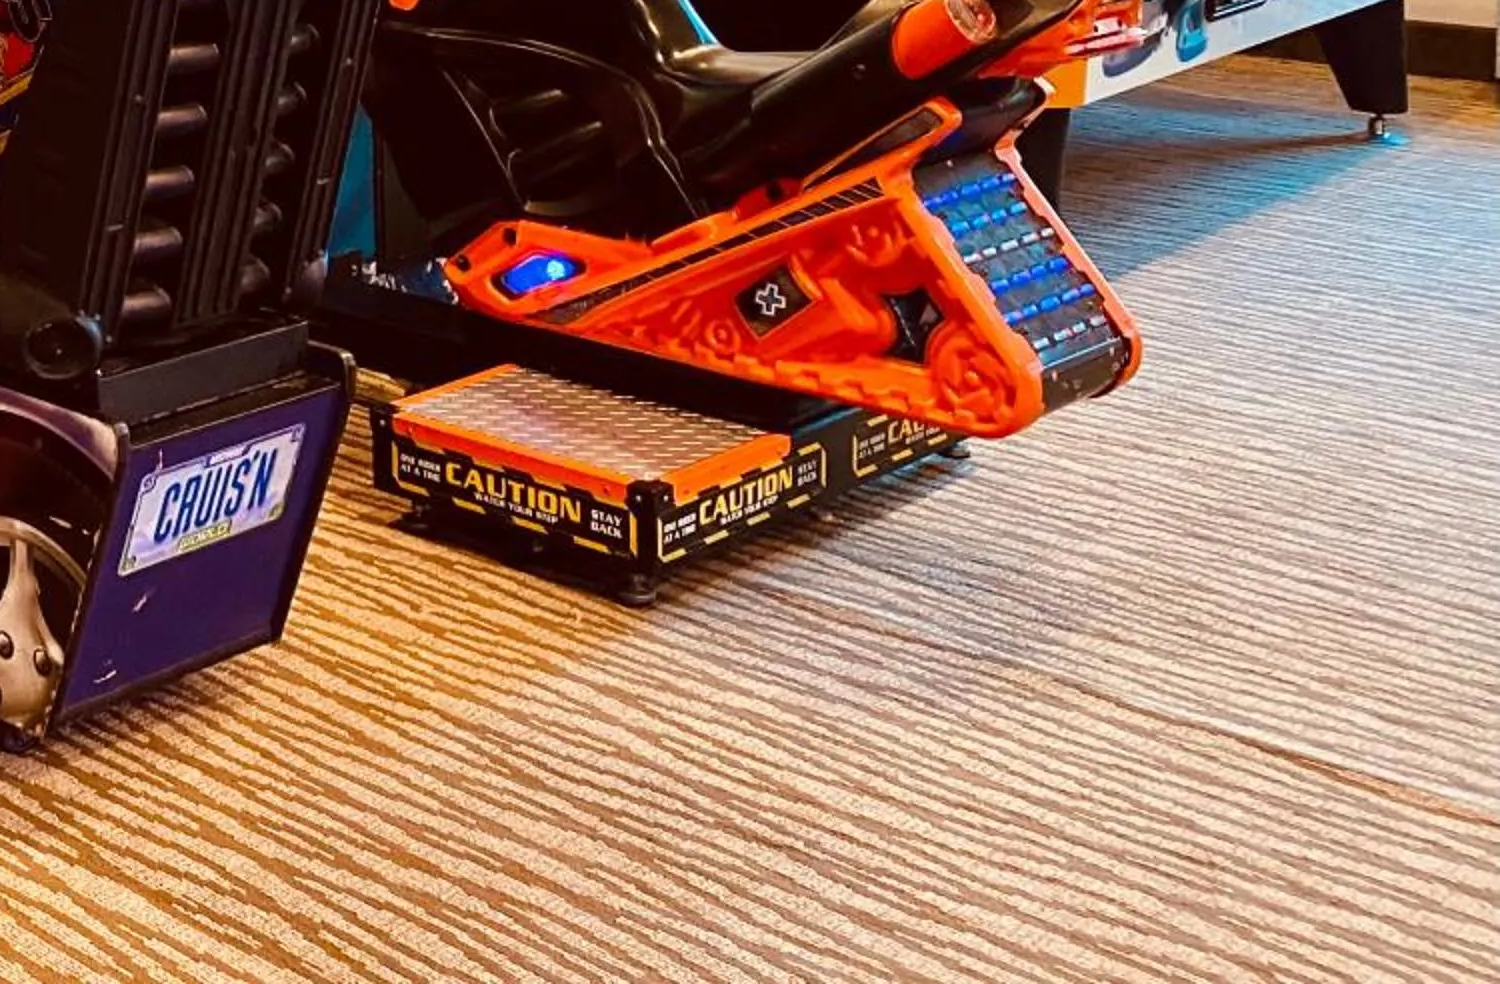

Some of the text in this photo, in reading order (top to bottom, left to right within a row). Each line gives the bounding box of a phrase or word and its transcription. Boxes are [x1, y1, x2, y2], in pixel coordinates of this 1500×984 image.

[153, 447, 278, 544] CRUIS'N
[445, 462, 582, 523] CAUTION
[591, 509, 623, 527] STAY
[699, 466, 793, 526] CAUTION
[590, 521, 623, 539] BACK
